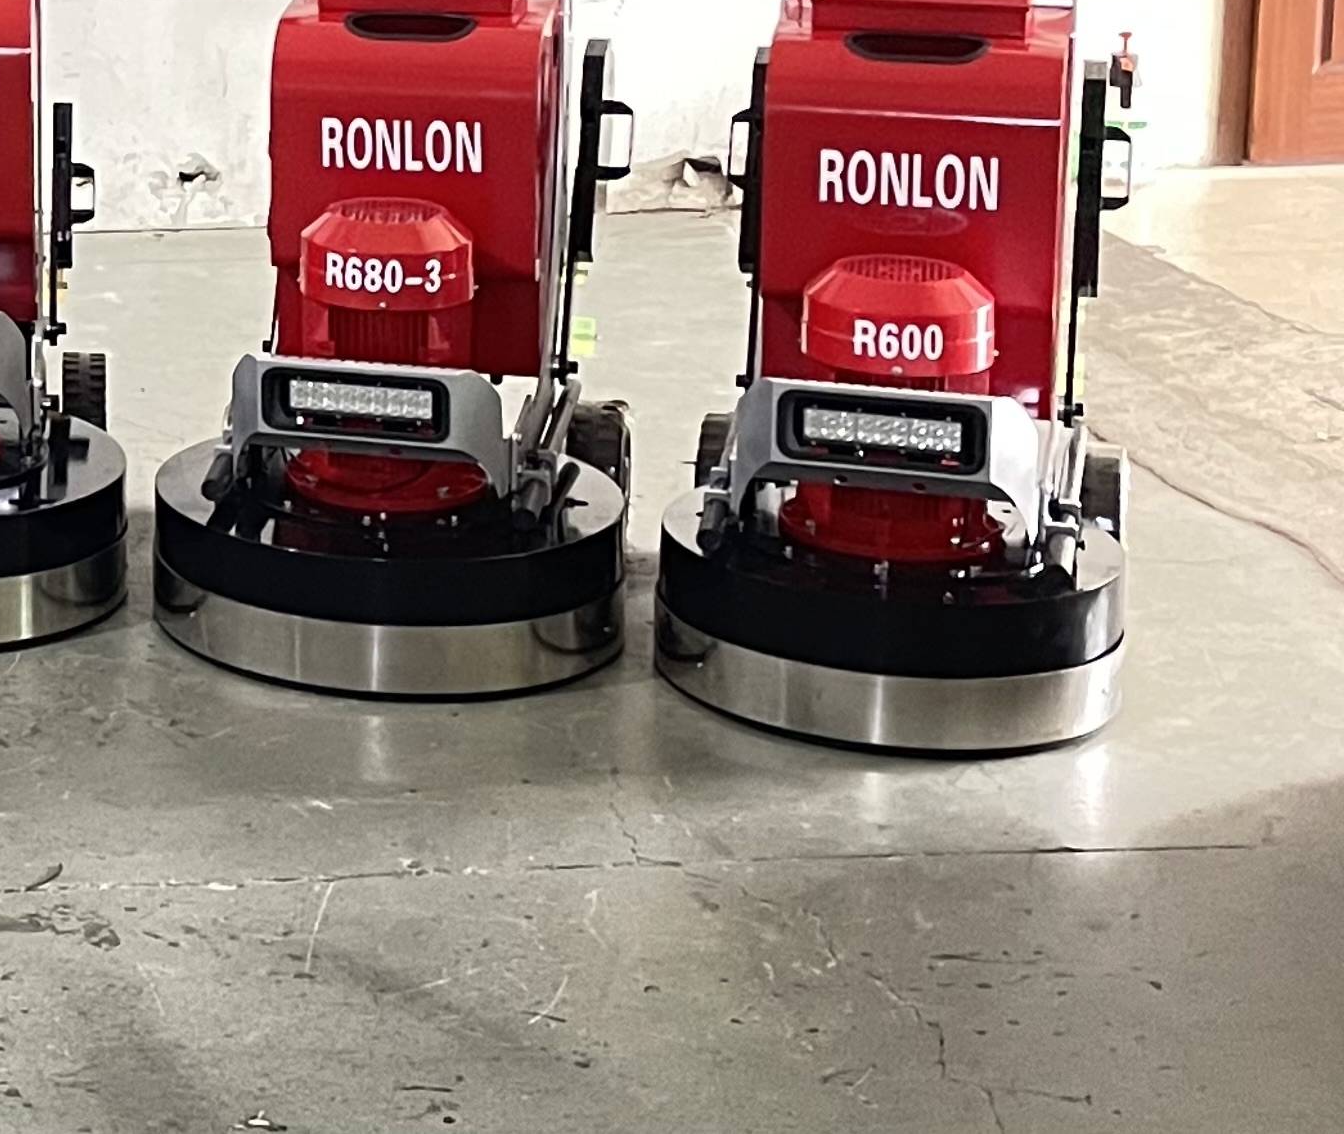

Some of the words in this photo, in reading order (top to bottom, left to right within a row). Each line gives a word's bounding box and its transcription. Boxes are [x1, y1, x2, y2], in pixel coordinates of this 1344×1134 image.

[320, 117, 482, 173] RONLON
[818, 148, 999, 211] RONLON
[325, 251, 442, 294] R680-3
[852, 319, 944, 362] R600
